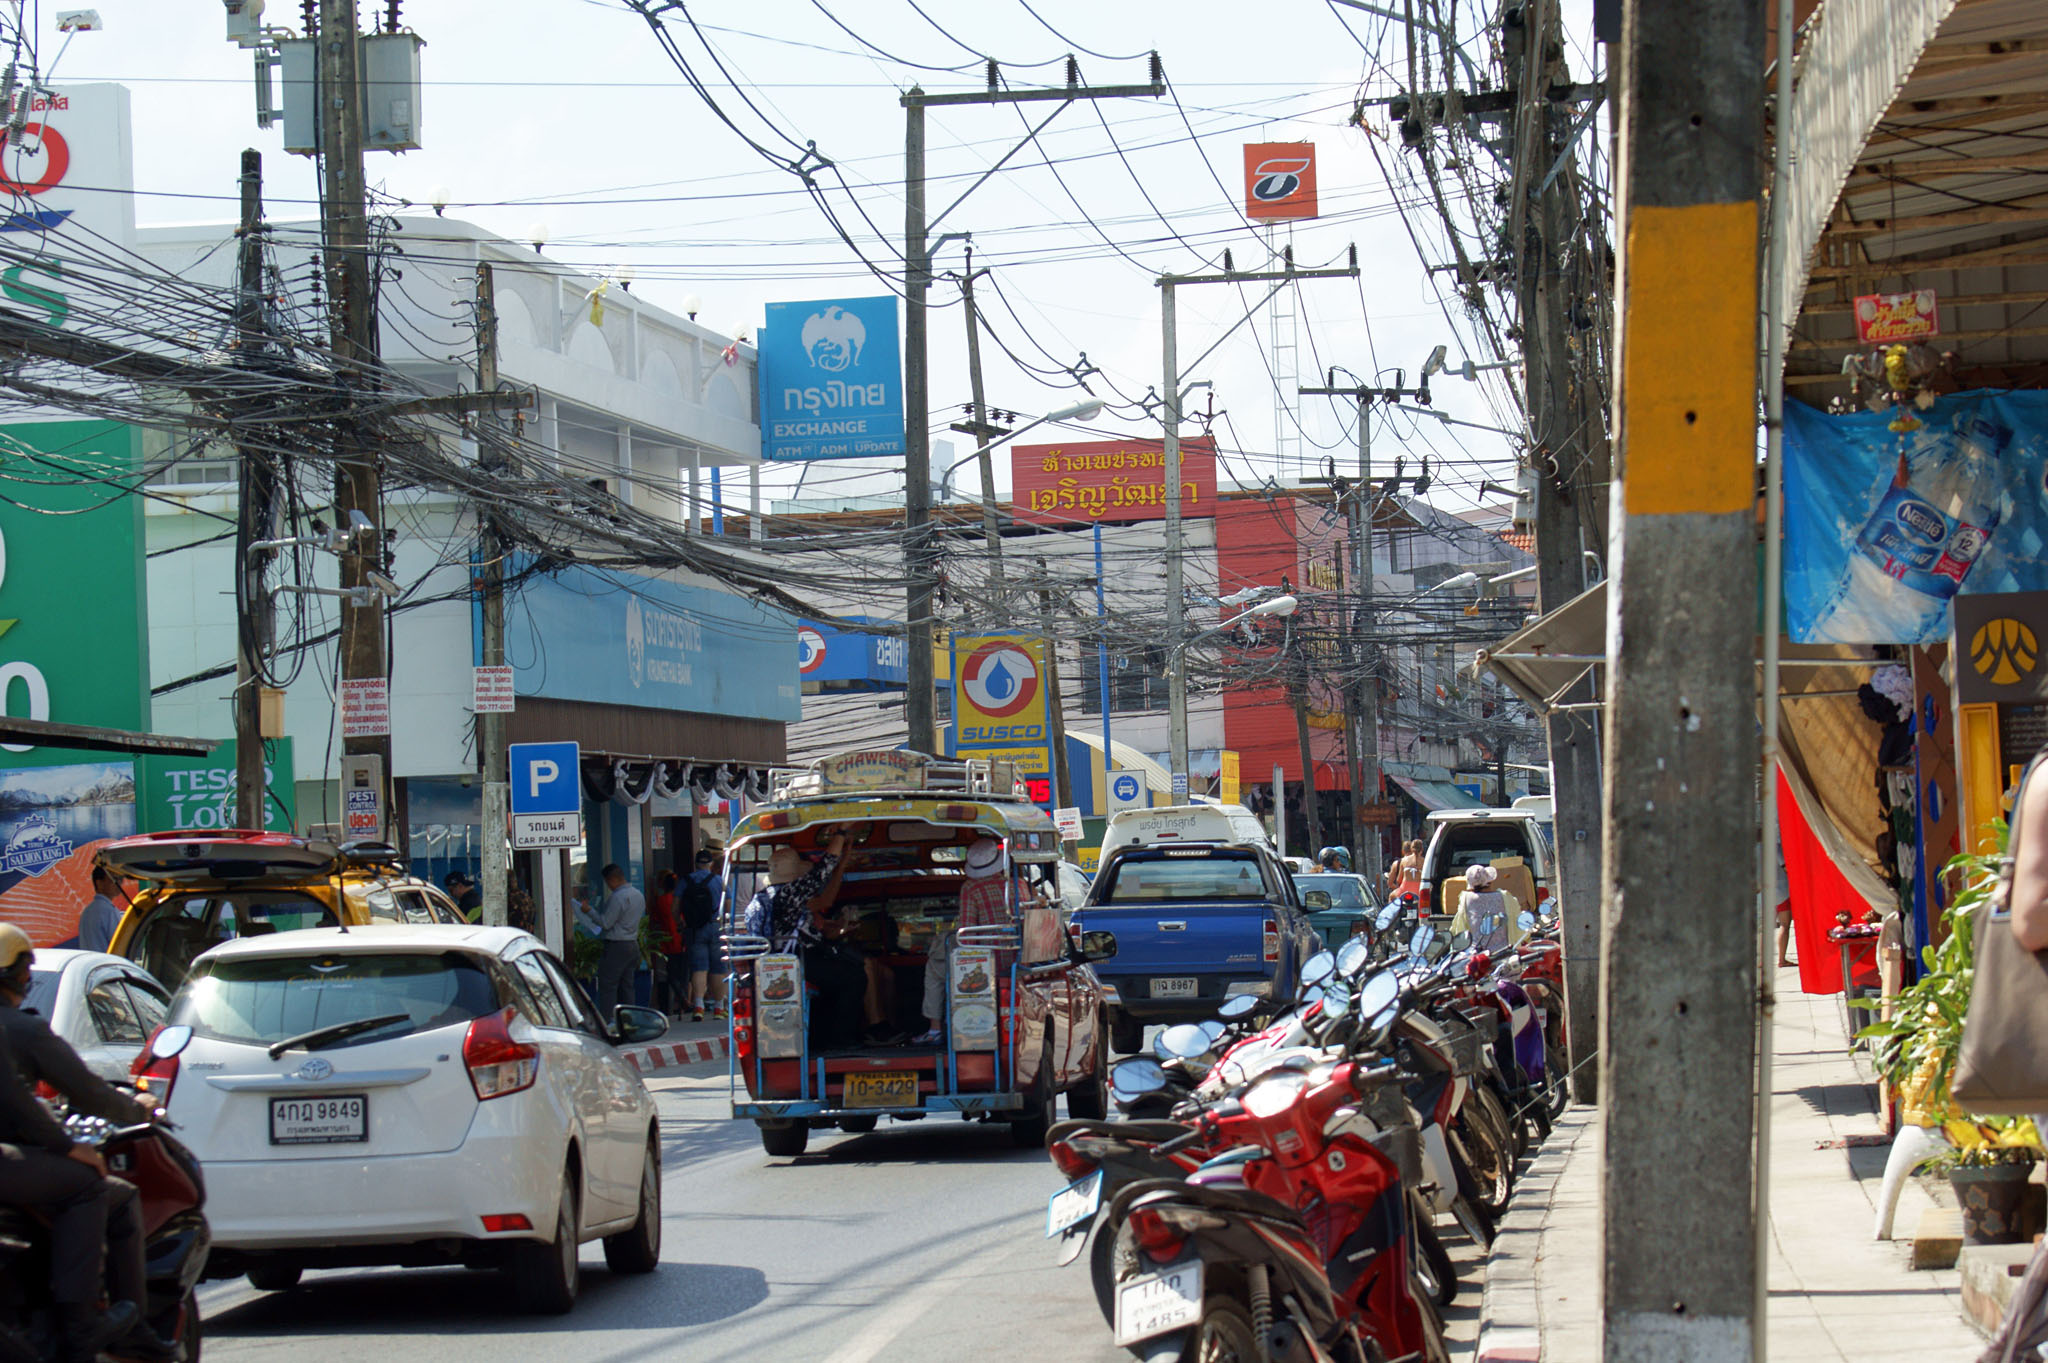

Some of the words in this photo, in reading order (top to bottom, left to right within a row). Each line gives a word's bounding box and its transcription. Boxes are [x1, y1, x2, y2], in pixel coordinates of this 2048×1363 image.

[784, 381, 885, 416] กรุงไทย
[774, 420, 867, 437] EXCHANGE
[776, 446, 801, 457] ATM
[820, 444, 847, 455] ADM
[855, 441, 898, 452] UPDATE
[962, 725, 1042, 740] SUSCO
[530, 760, 559, 797] P
[349, 791, 375, 802] PEST
[349, 802, 376, 811] CONTROL
[528, 817, 565, 832] รถยนต์
[518, 837, 535, 849] CAR
[539, 835, 577, 848] PARKING
[1171, 980, 1194, 991] 8967
[850, 1080, 914, 1097] 10-3429
[318, 1101, 360, 1119] 9849
